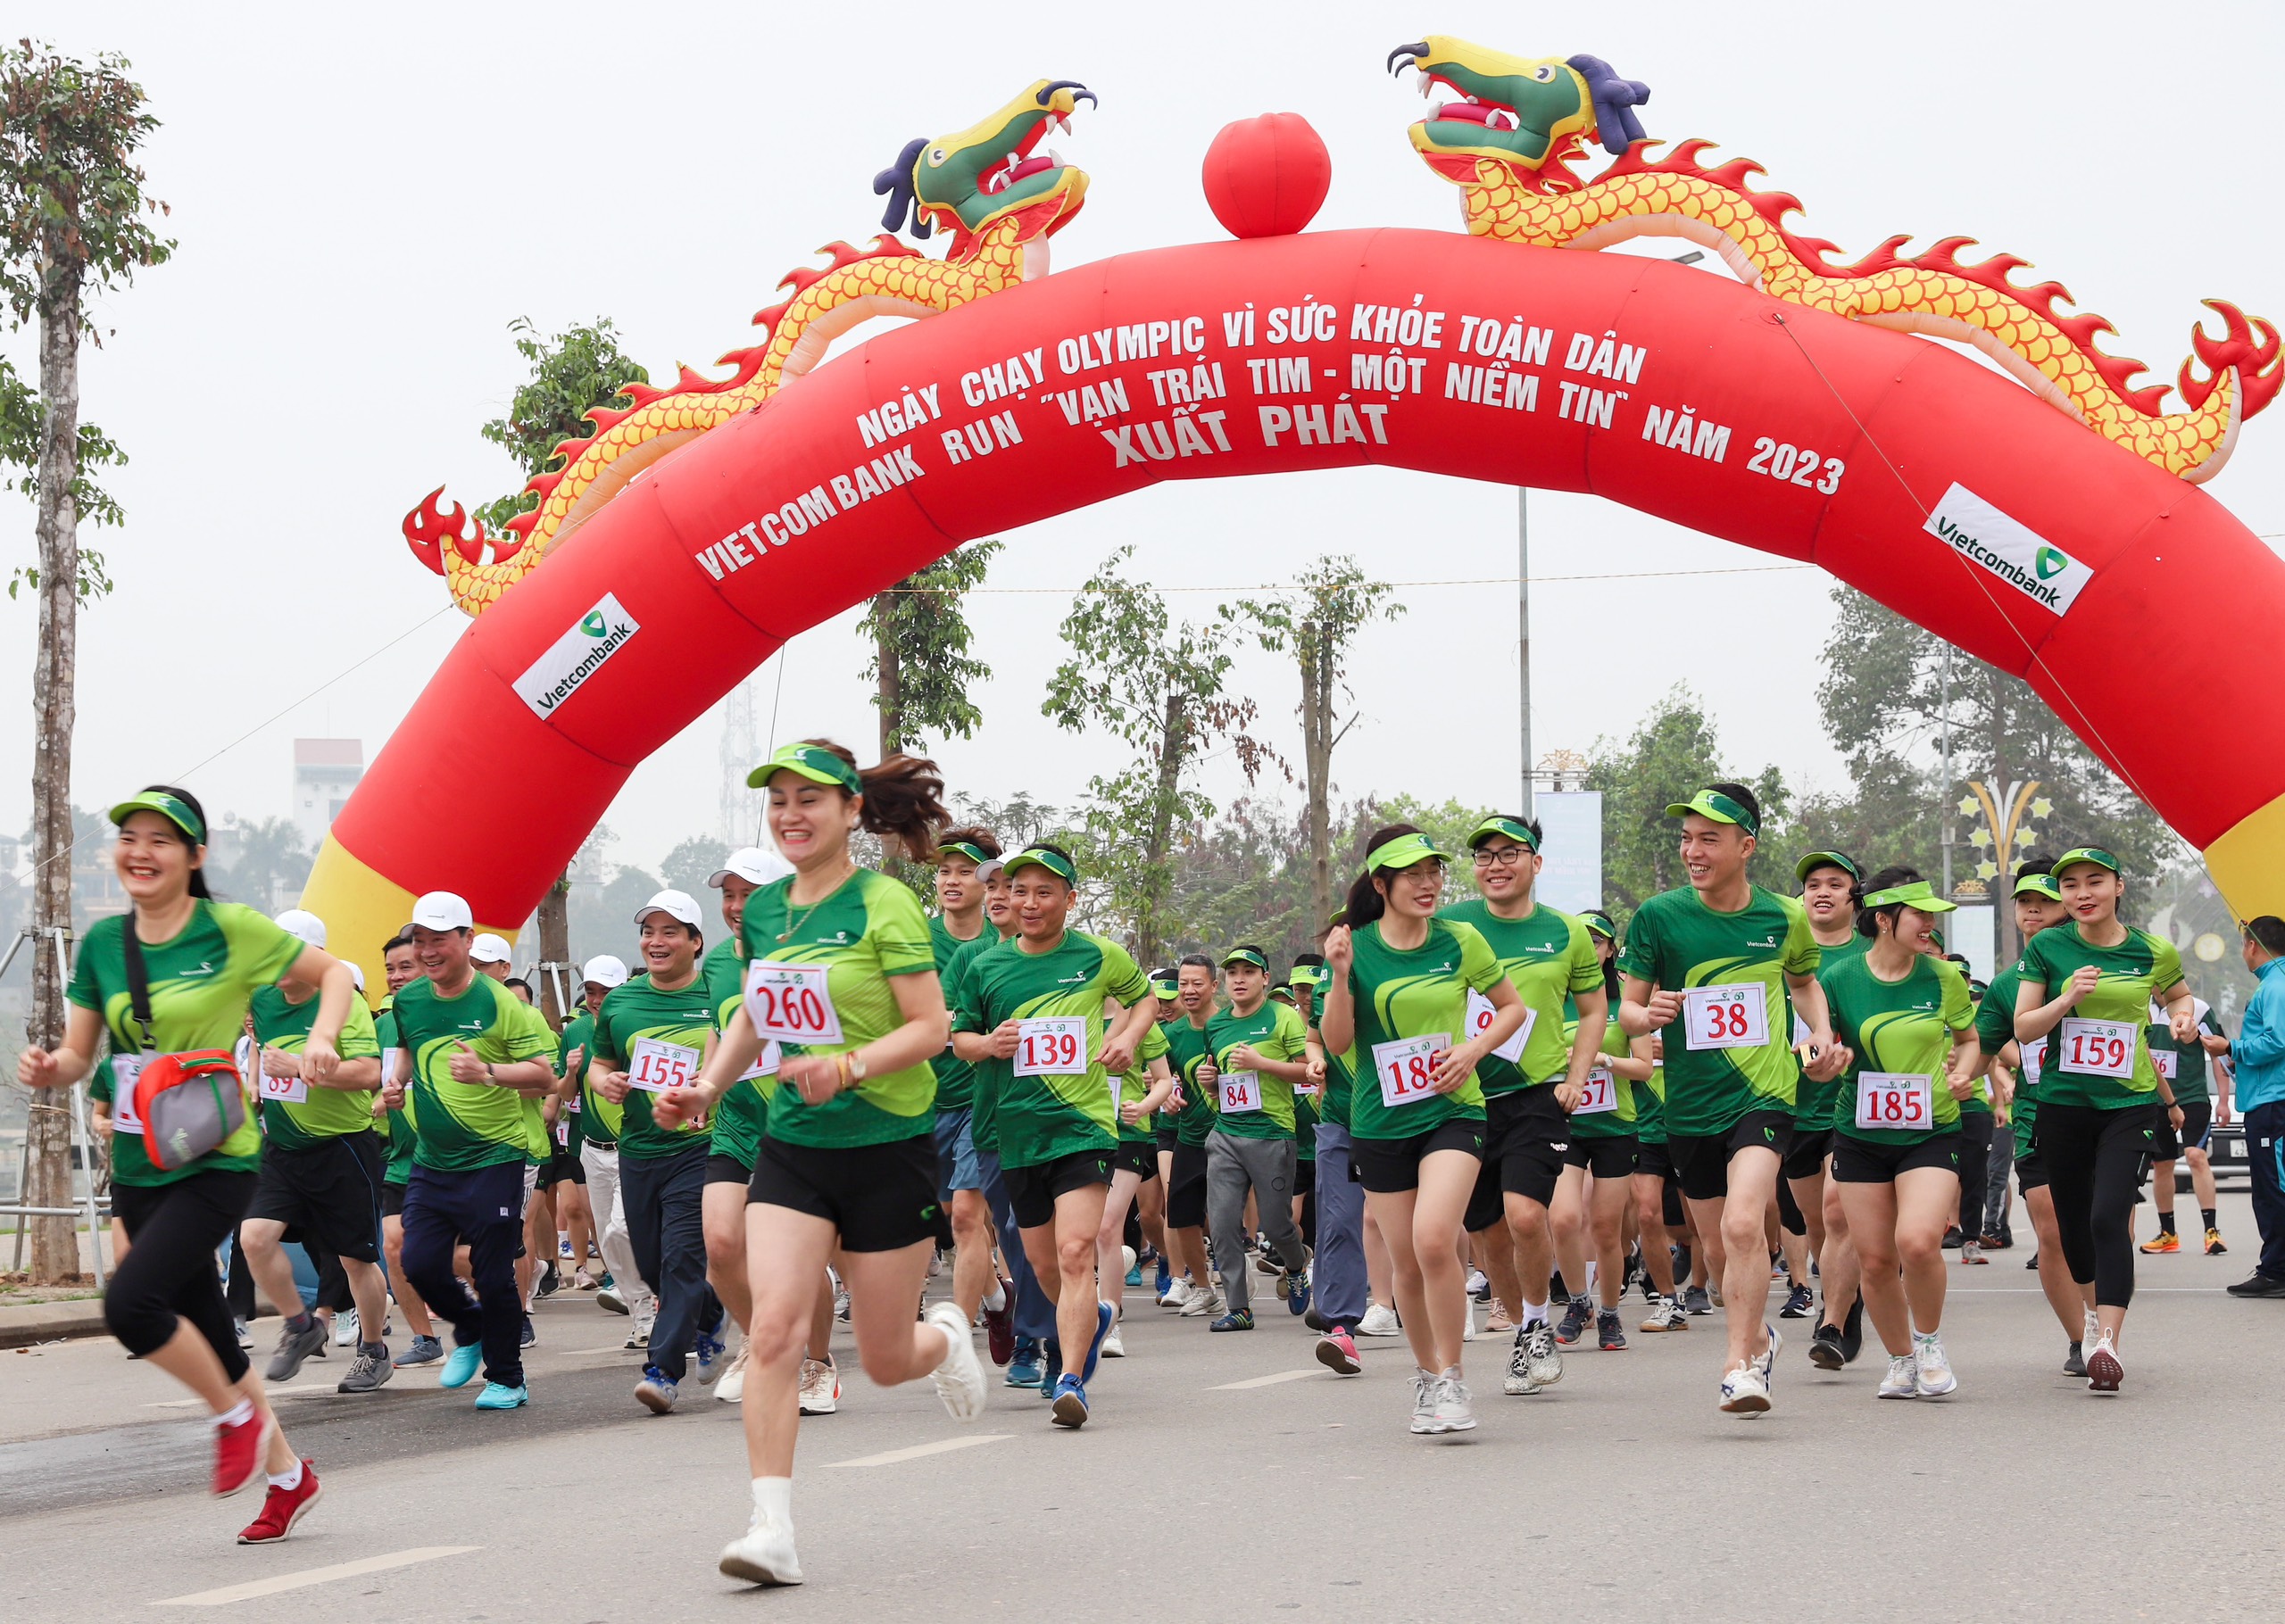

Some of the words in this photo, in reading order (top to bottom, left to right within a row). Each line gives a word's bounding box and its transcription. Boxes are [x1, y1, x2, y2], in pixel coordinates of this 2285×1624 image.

[857, 385, 942, 448] NGÀY
[960, 347, 1044, 407] CHẠY
[1058, 317, 1205, 375] OLYMPIC
[1222, 302, 1255, 348] VÌ
[1266, 294, 1337, 344] SỨC
[1350, 294, 1446, 349] KHỎE
[1458, 302, 1553, 366] TOÀN
[1565, 330, 1648, 385] DÂN
[941, 409, 1024, 465] RUN
[1146, 355, 1227, 407] TRÁI
[1247, 357, 1312, 394] TIM
[1350, 347, 1427, 401] MỘT
[1444, 360, 1540, 412] NIỀM
[1641, 404, 1732, 463] NĂM
[1746, 436, 1846, 495] 2023
[1100, 403, 1233, 468] XUẤT
[1258, 392, 1389, 447] PHÁT
[1937, 516, 2062, 609] Vietcombank
[536, 623, 631, 709] Vietcombank
[1747, 940, 1776, 949] Vietcombank
[756, 986, 826, 1032] 260
[1707, 1002, 1749, 1039] 38
[1024, 1033, 1077, 1067] 139
[2070, 1035, 2125, 1068] 159
[636, 1055, 687, 1088] 155
[1388, 1048, 1448, 1096] 186
[1226, 1084, 1249, 1106] 84
[1866, 1090, 1923, 1122] 185
